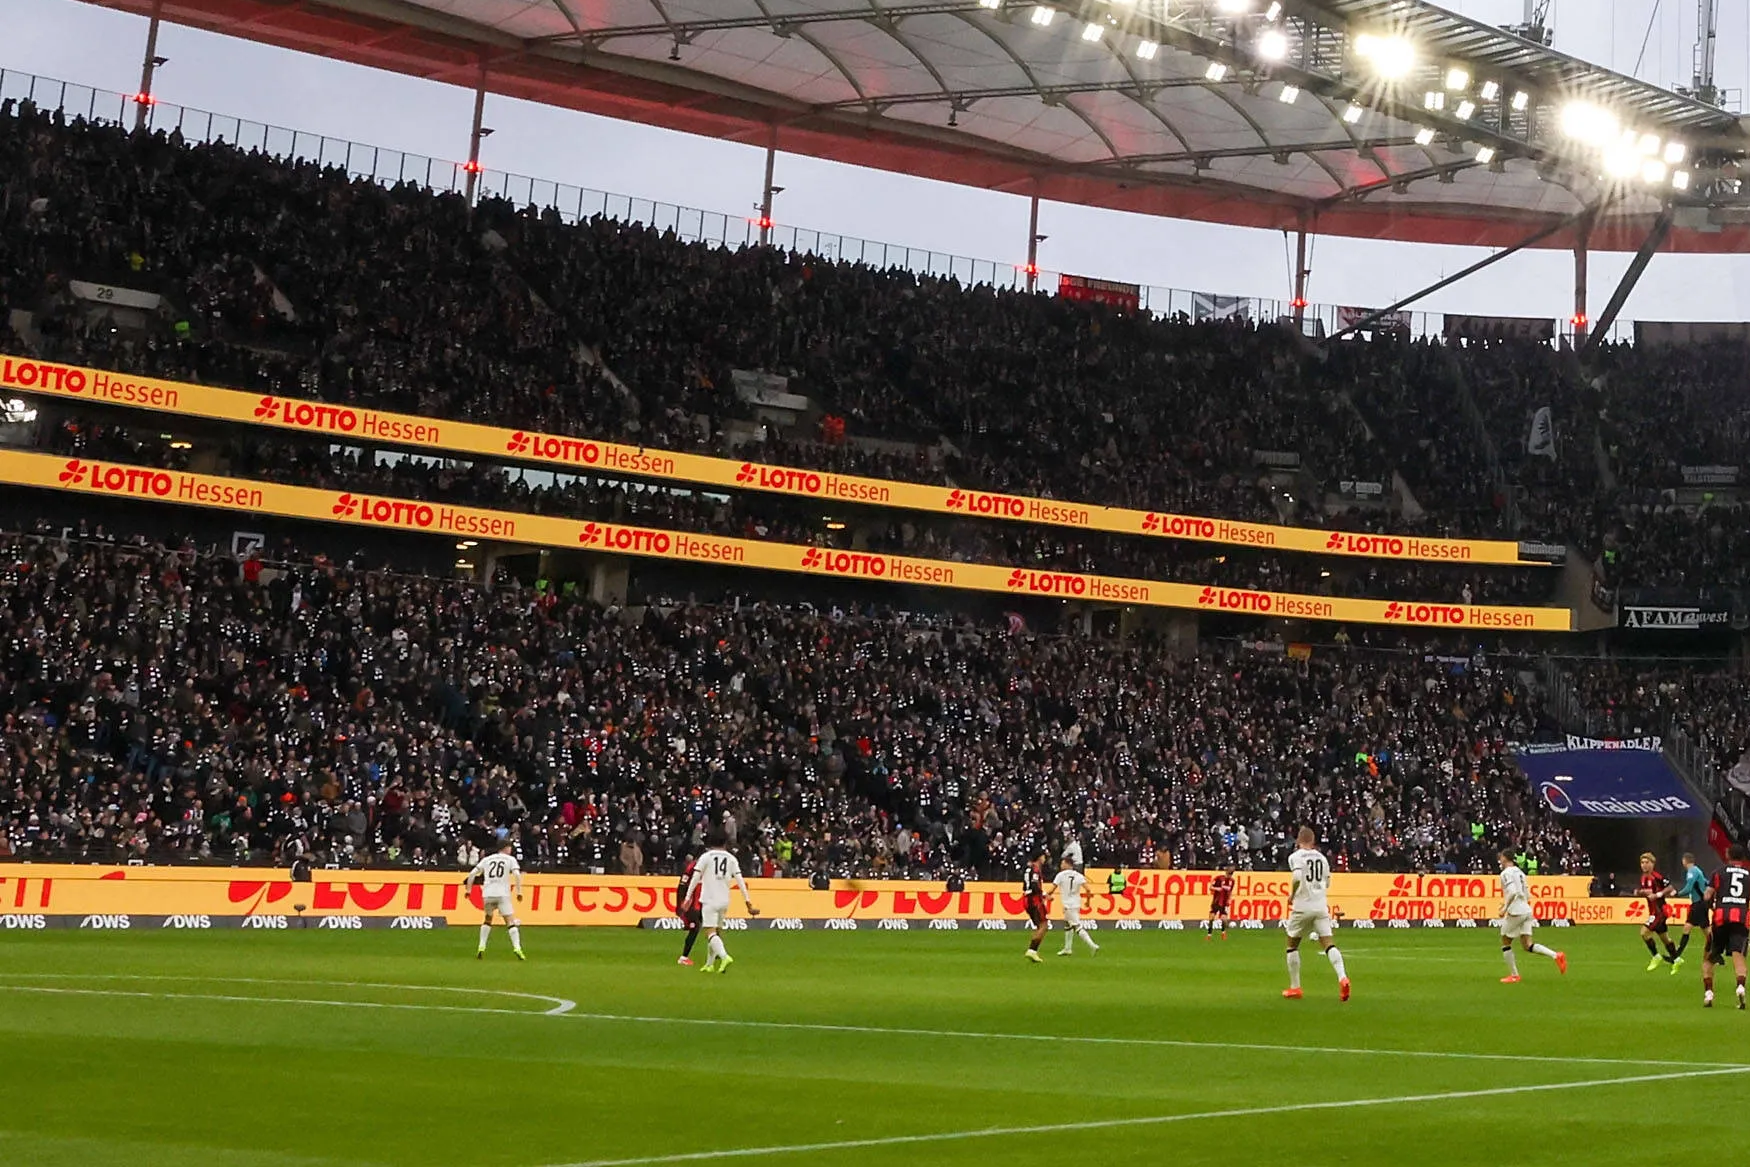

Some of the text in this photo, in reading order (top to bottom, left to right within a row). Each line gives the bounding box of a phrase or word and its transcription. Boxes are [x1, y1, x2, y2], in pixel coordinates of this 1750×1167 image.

[97, 288, 113, 300] 29
[3, 359, 179, 407] LOTTO Hessen
[283, 401, 440, 443] LOTTO Hessen
[533, 436, 675, 474] LOTTO Hessen
[91, 465, 263, 507] LOTTO Hessen
[760, 468, 890, 502] LOTTO Hessen
[361, 498, 515, 536] LOTTO Hessen
[969, 493, 1089, 525] LOTTO Hessen
[1162, 515, 1275, 545] LOTTO Hessen
[605, 527, 744, 561] LOTTO Hessen
[1347, 533, 1470, 559] LOTTO Hessen
[825, 552, 954, 583] LOTTO Hessen
[1030, 572, 1150, 601] LOTTO Hessen
[1219, 590, 1333, 617] LOTTO Hessen
[1407, 605, 1534, 627] LOTTO Hessen
[1579, 796, 1691, 813] mainova
[489, 861, 505, 878] 26
[714, 856, 727, 876] 14
[1306, 859, 1323, 882] 30
[1068, 876, 1075, 889] 7
[1730, 872, 1744, 897] 5
[1389, 900, 1486, 919] LOTTO Hessen
[1531, 900, 1613, 920] OTTO Hessen
[6, 915, 46, 929] DWS
[92, 915, 131, 929] DWS
[175, 915, 211, 929] DWS
[252, 915, 288, 929] DWS
[328, 916, 362, 929] DWS
[400, 917, 433, 929] DWS
[776, 919, 803, 929] DWS
[831, 919, 857, 929] DWS
[884, 919, 909, 929] DWS
[935, 919, 959, 929] DWS
